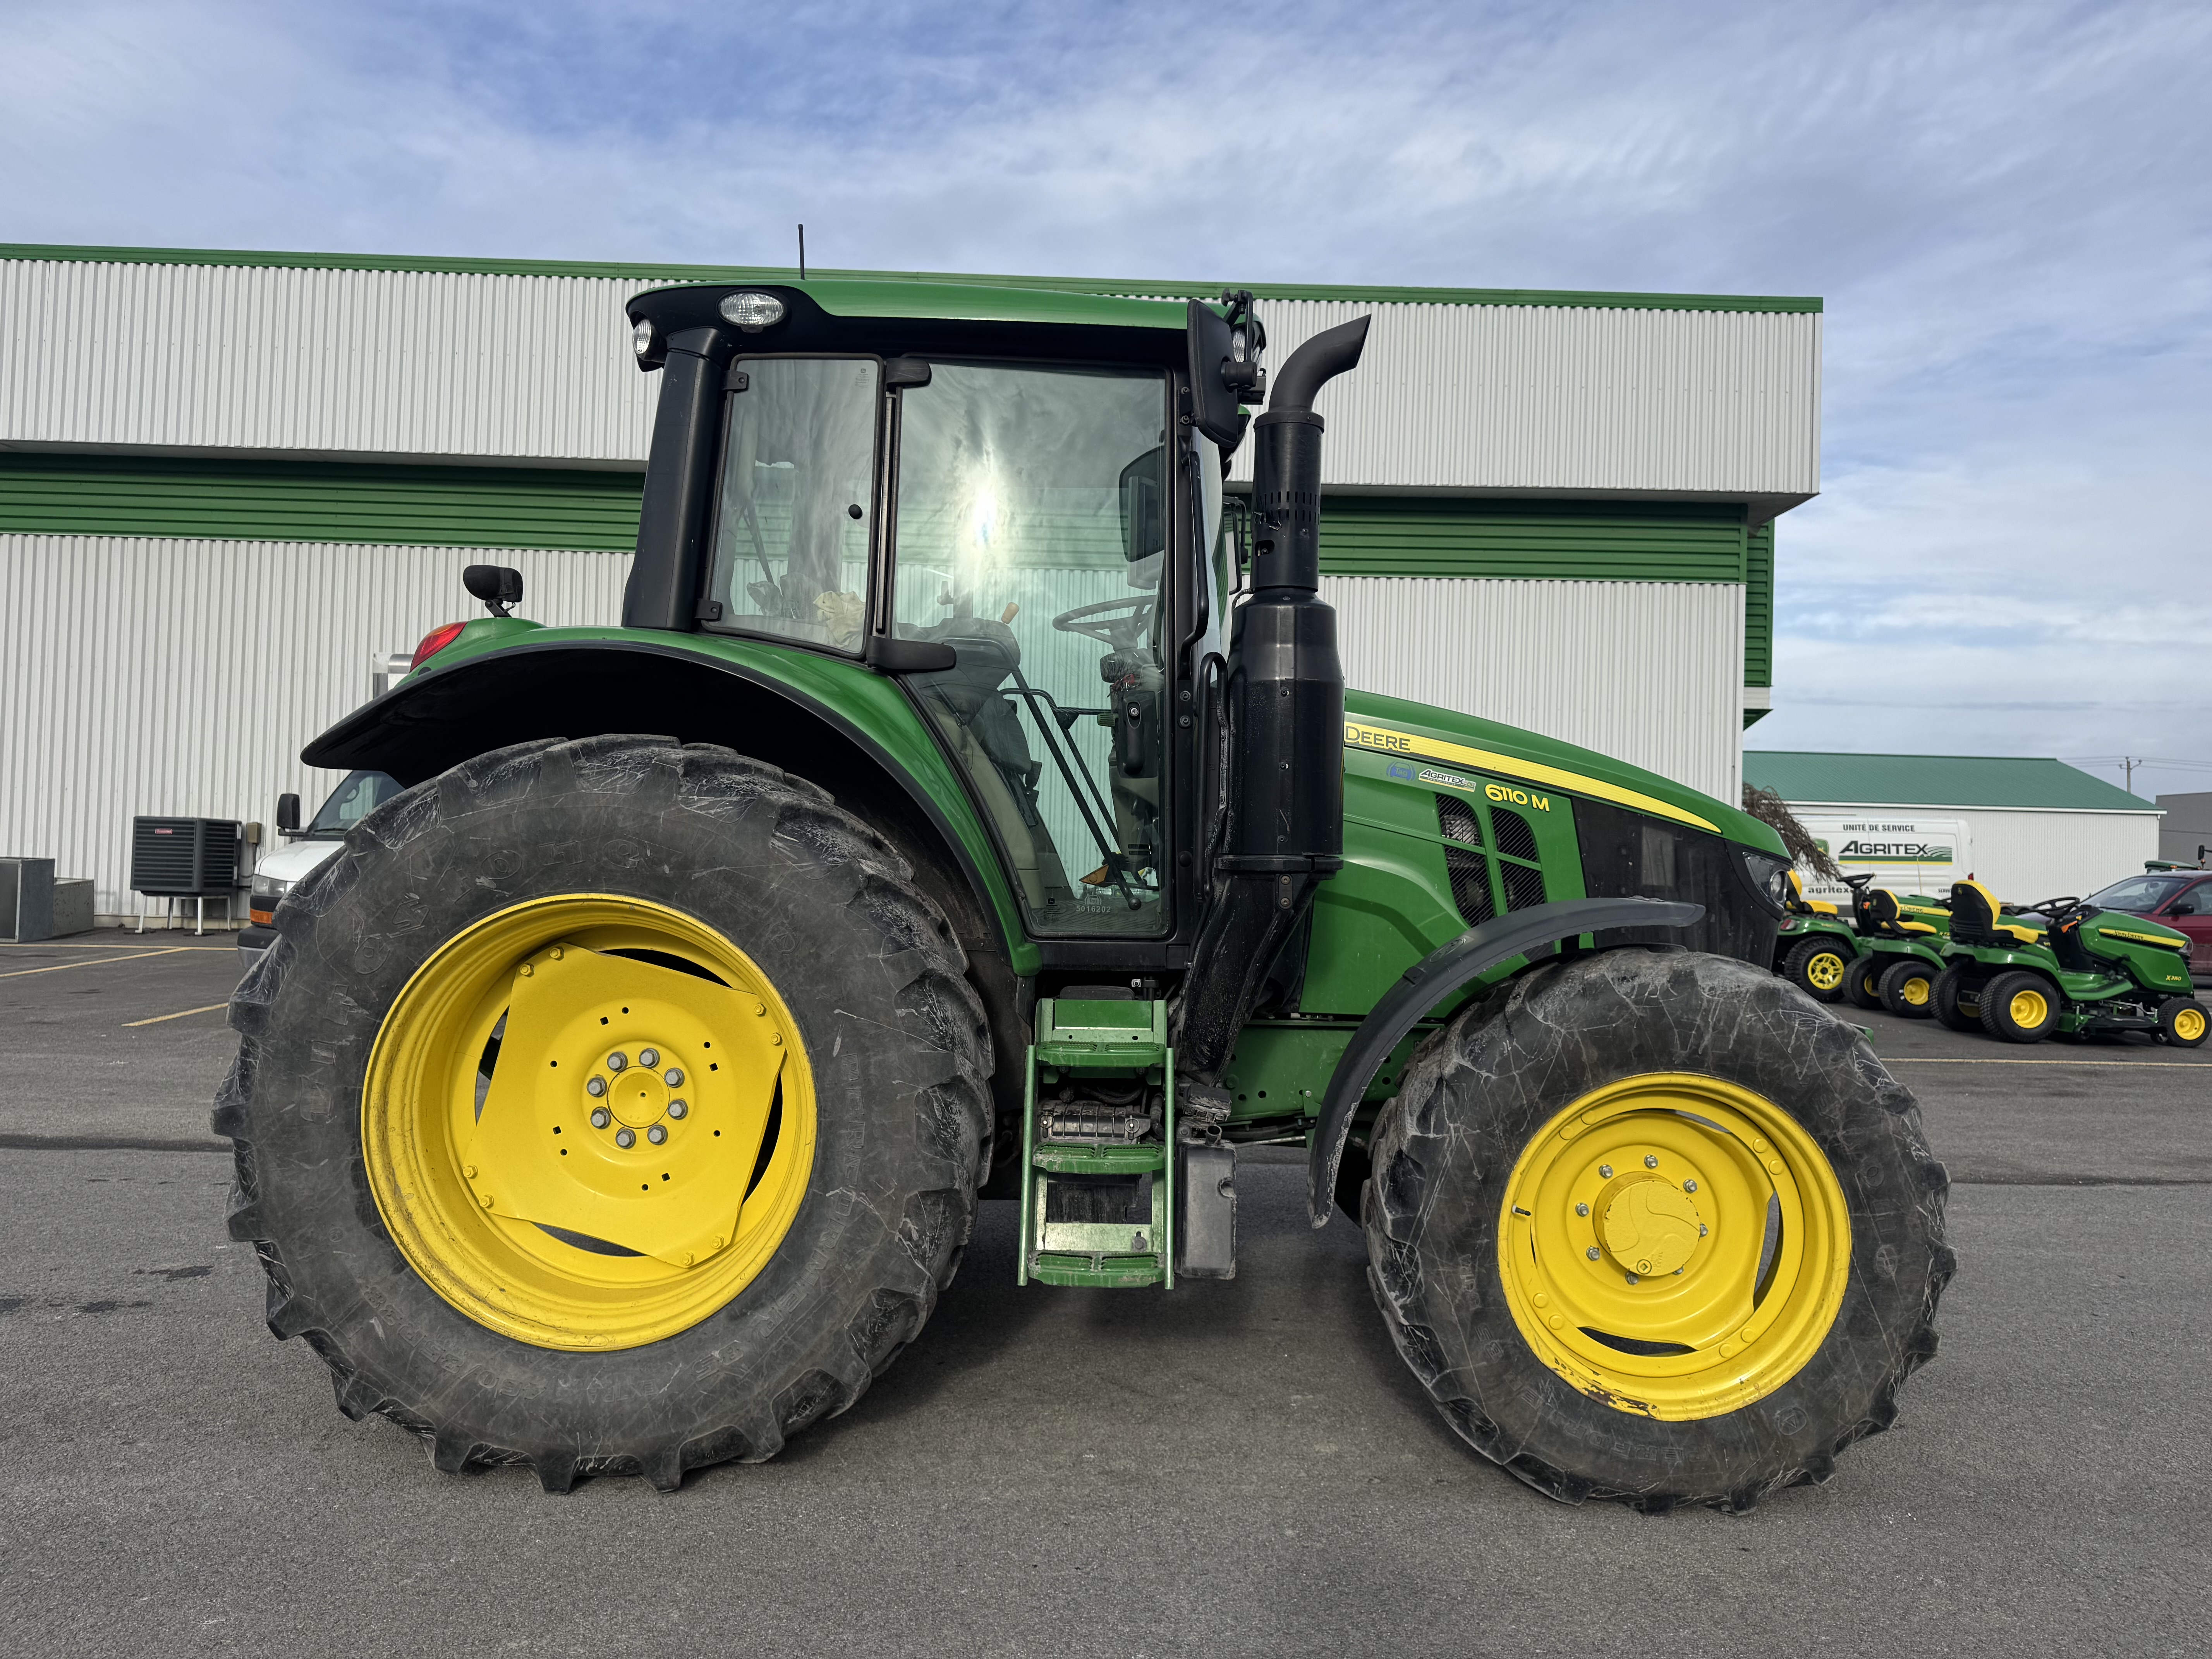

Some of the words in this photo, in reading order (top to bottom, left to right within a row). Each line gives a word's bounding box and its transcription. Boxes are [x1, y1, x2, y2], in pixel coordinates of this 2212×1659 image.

[1345, 725, 1410, 751] DEERE
[1421, 769, 1464, 785] AGRITEX
[1484, 783, 1528, 805] 6110
[1531, 794, 1550, 812] M
[1843, 822, 1866, 831] UNITÉ
[1839, 840, 1929, 855] AGRITEX
[751, 1051, 870, 1338] PERFORMER
[690, 1339, 747, 1381] 85
